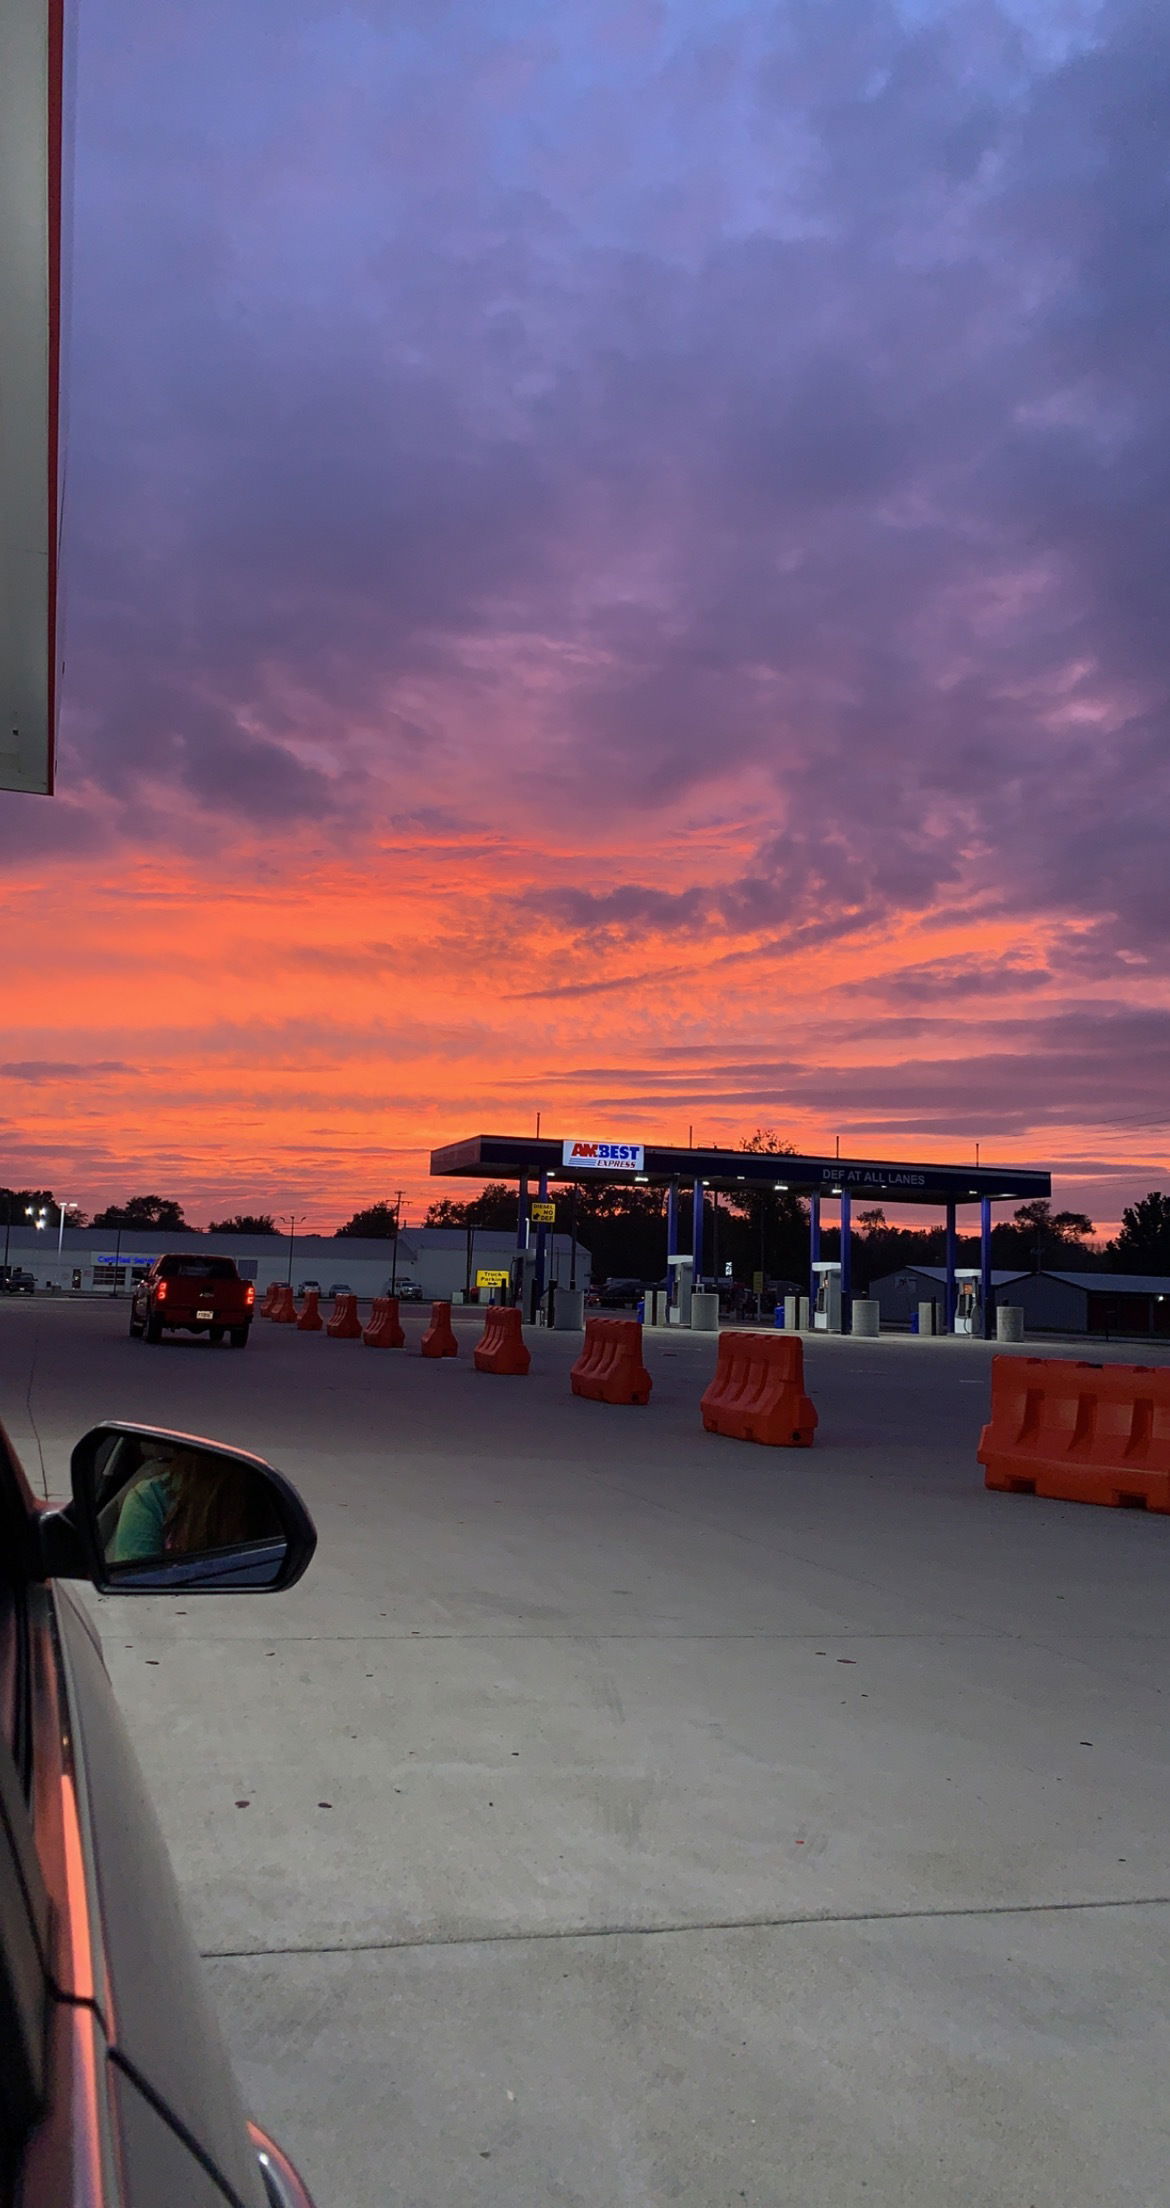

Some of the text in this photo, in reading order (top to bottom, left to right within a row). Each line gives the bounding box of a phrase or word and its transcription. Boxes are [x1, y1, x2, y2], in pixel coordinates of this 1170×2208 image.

[572, 1143, 640, 1160] AMBEST
[597, 1159, 637, 1168] EXPRESS
[822, 1168, 926, 1185] DEF AT ALL LANES
